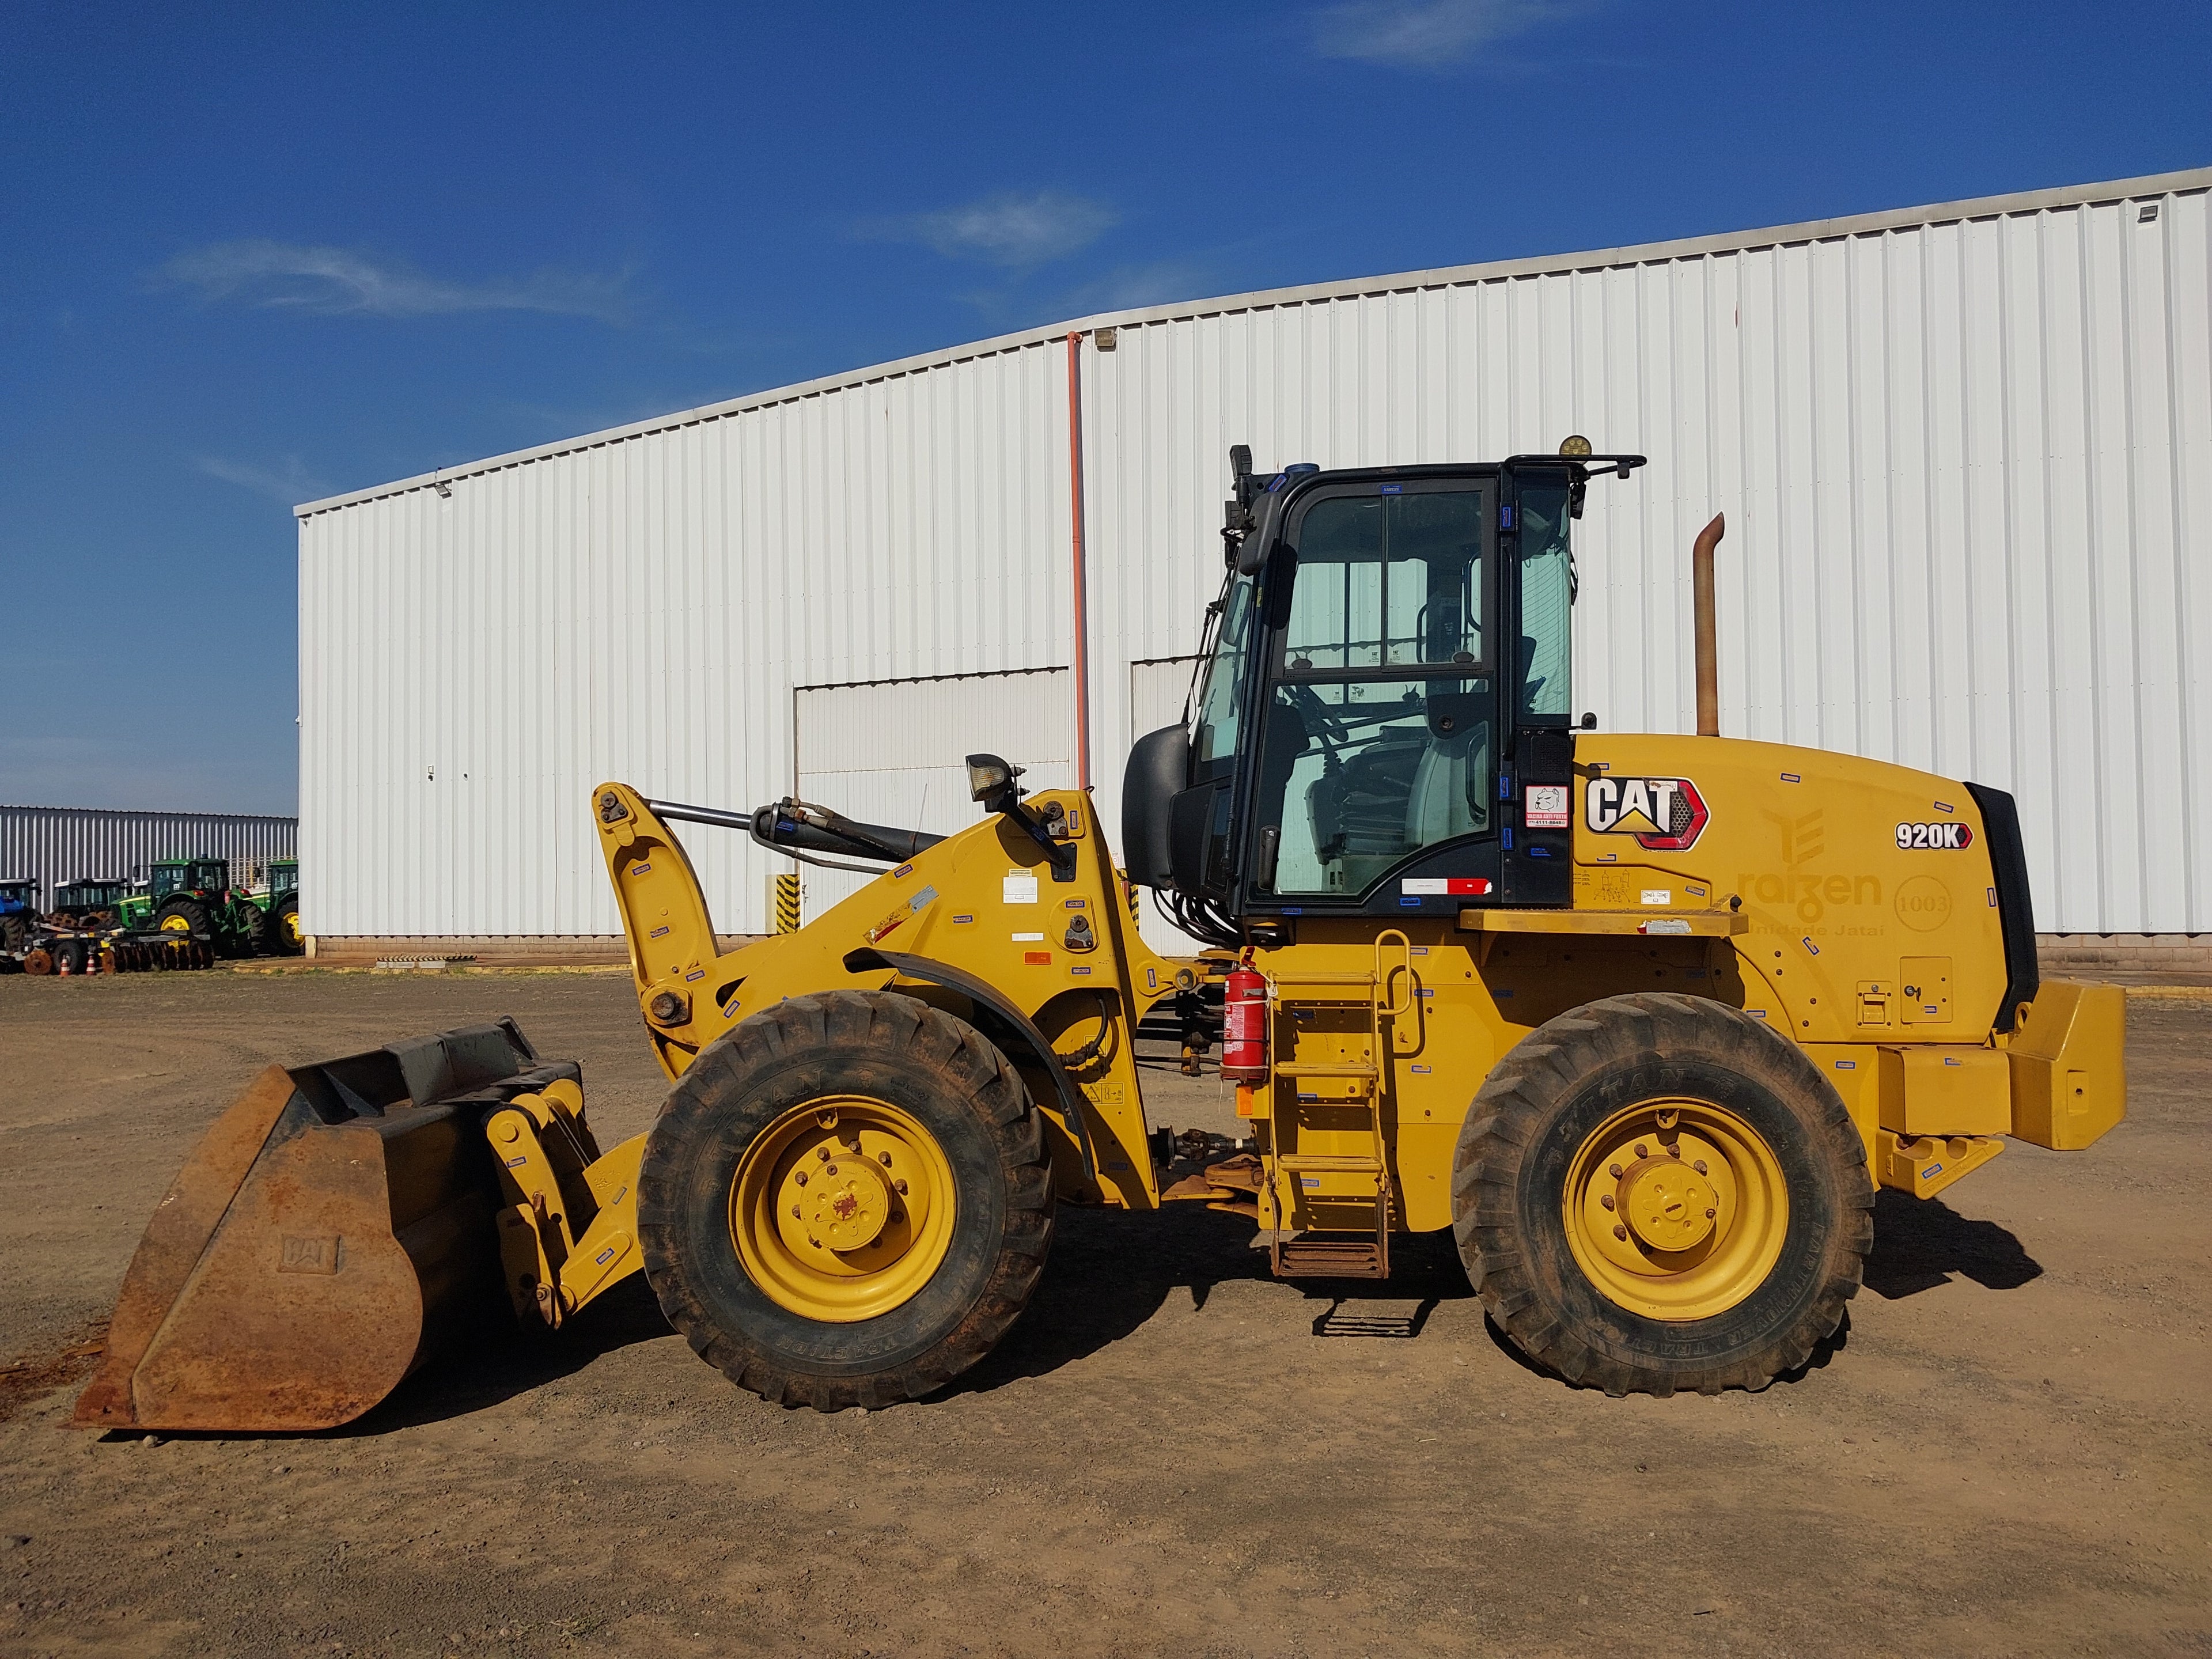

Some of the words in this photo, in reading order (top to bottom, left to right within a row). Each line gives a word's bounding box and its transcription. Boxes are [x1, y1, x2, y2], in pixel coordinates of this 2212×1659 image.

[1588, 778, 1677, 833] CAT
[1897, 824, 1960, 848] 920K
[1899, 895, 1948, 912] 1003
